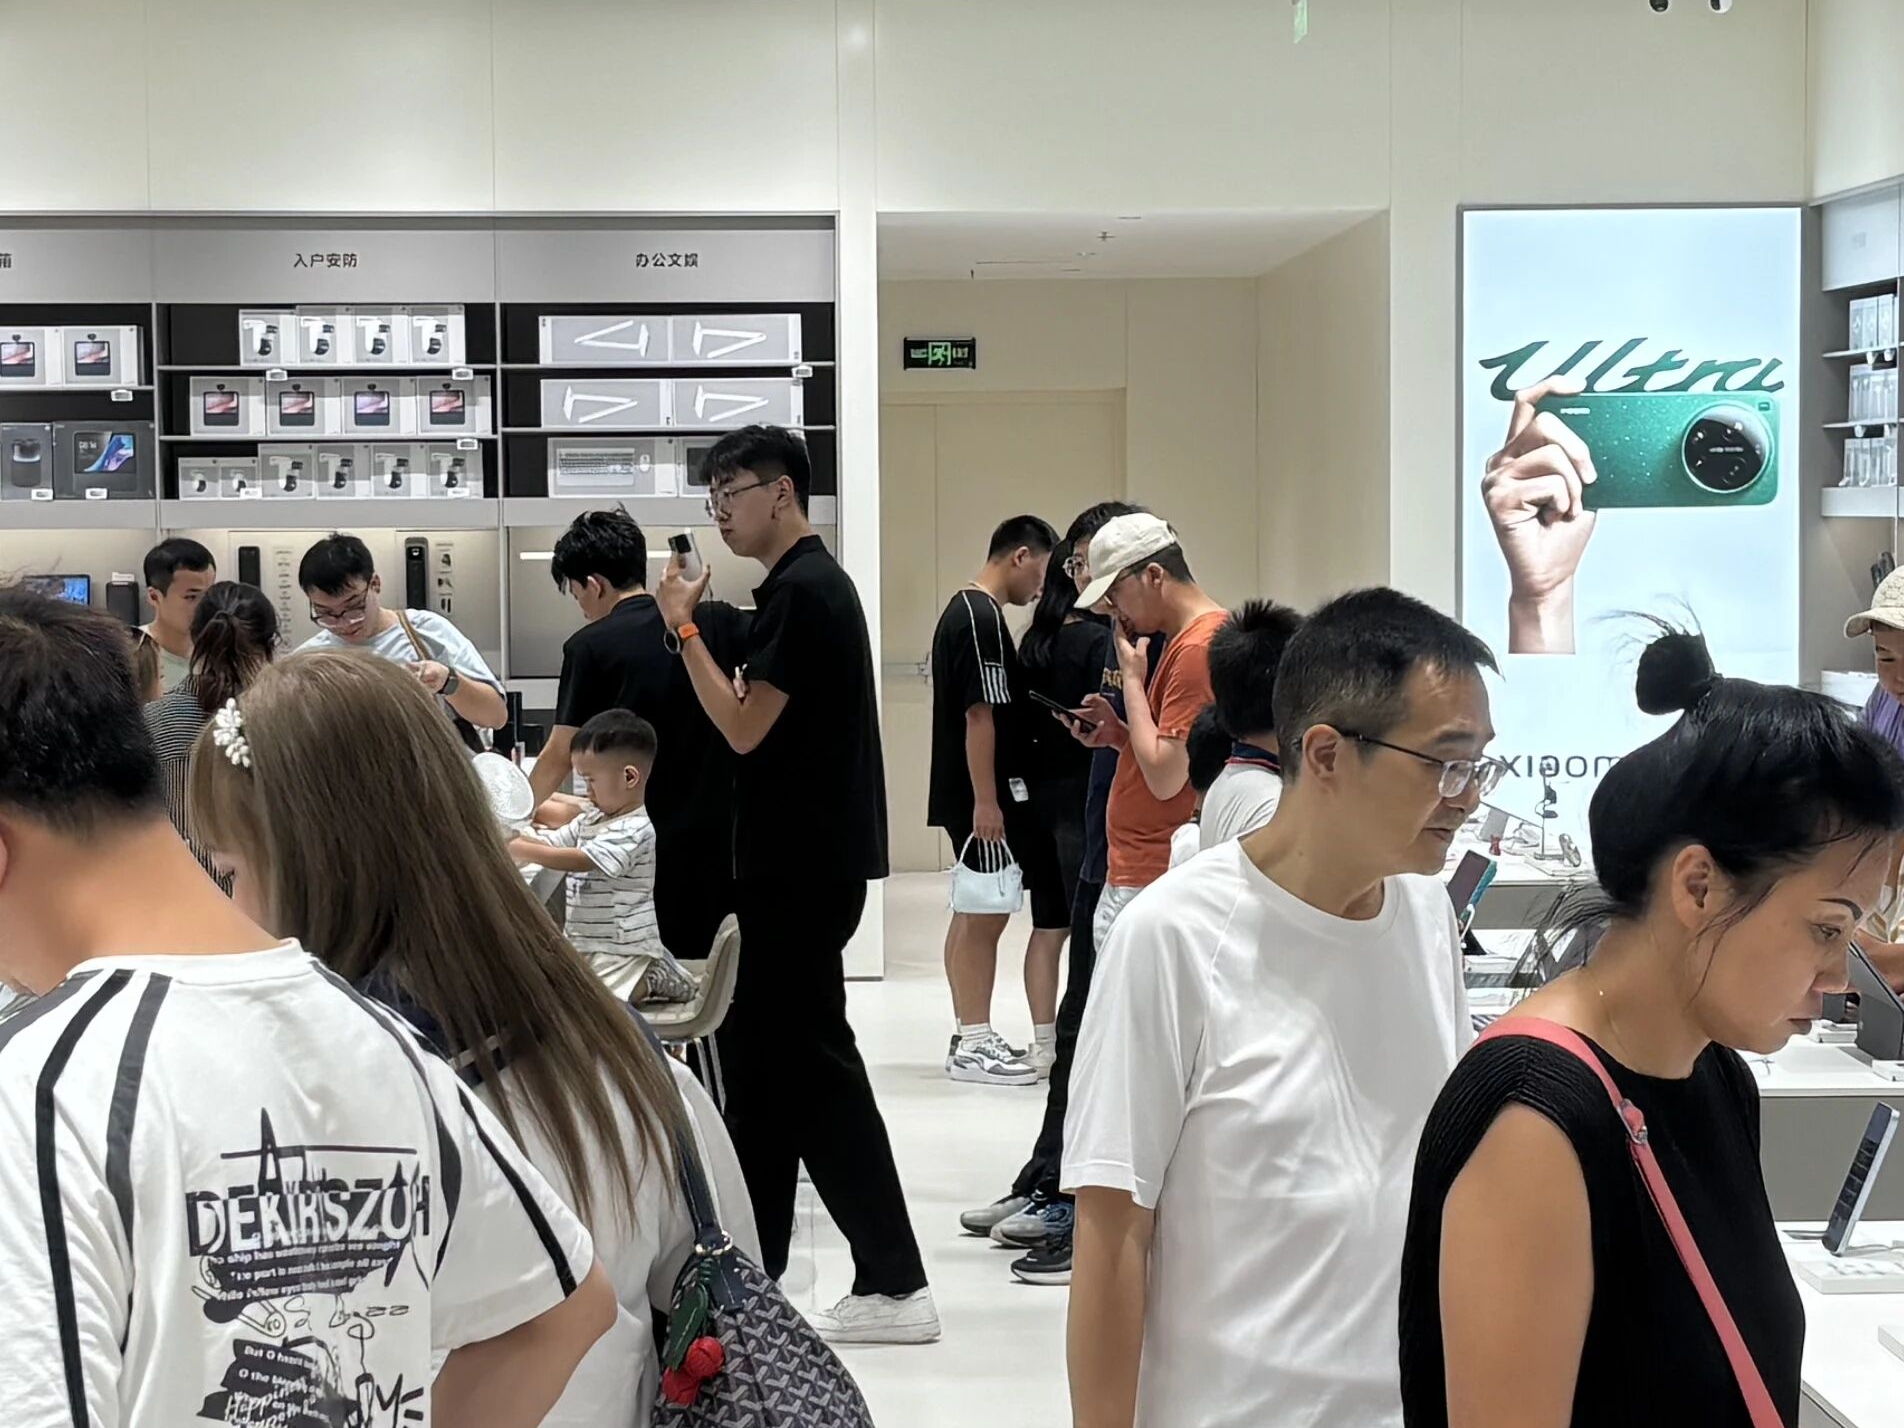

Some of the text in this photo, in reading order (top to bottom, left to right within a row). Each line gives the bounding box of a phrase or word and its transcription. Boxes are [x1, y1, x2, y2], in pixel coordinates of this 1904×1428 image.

[293, 252, 358, 269] 入户安防
[1479, 337, 1785, 402] Ultra
[1499, 754, 1622, 778] xiaom
